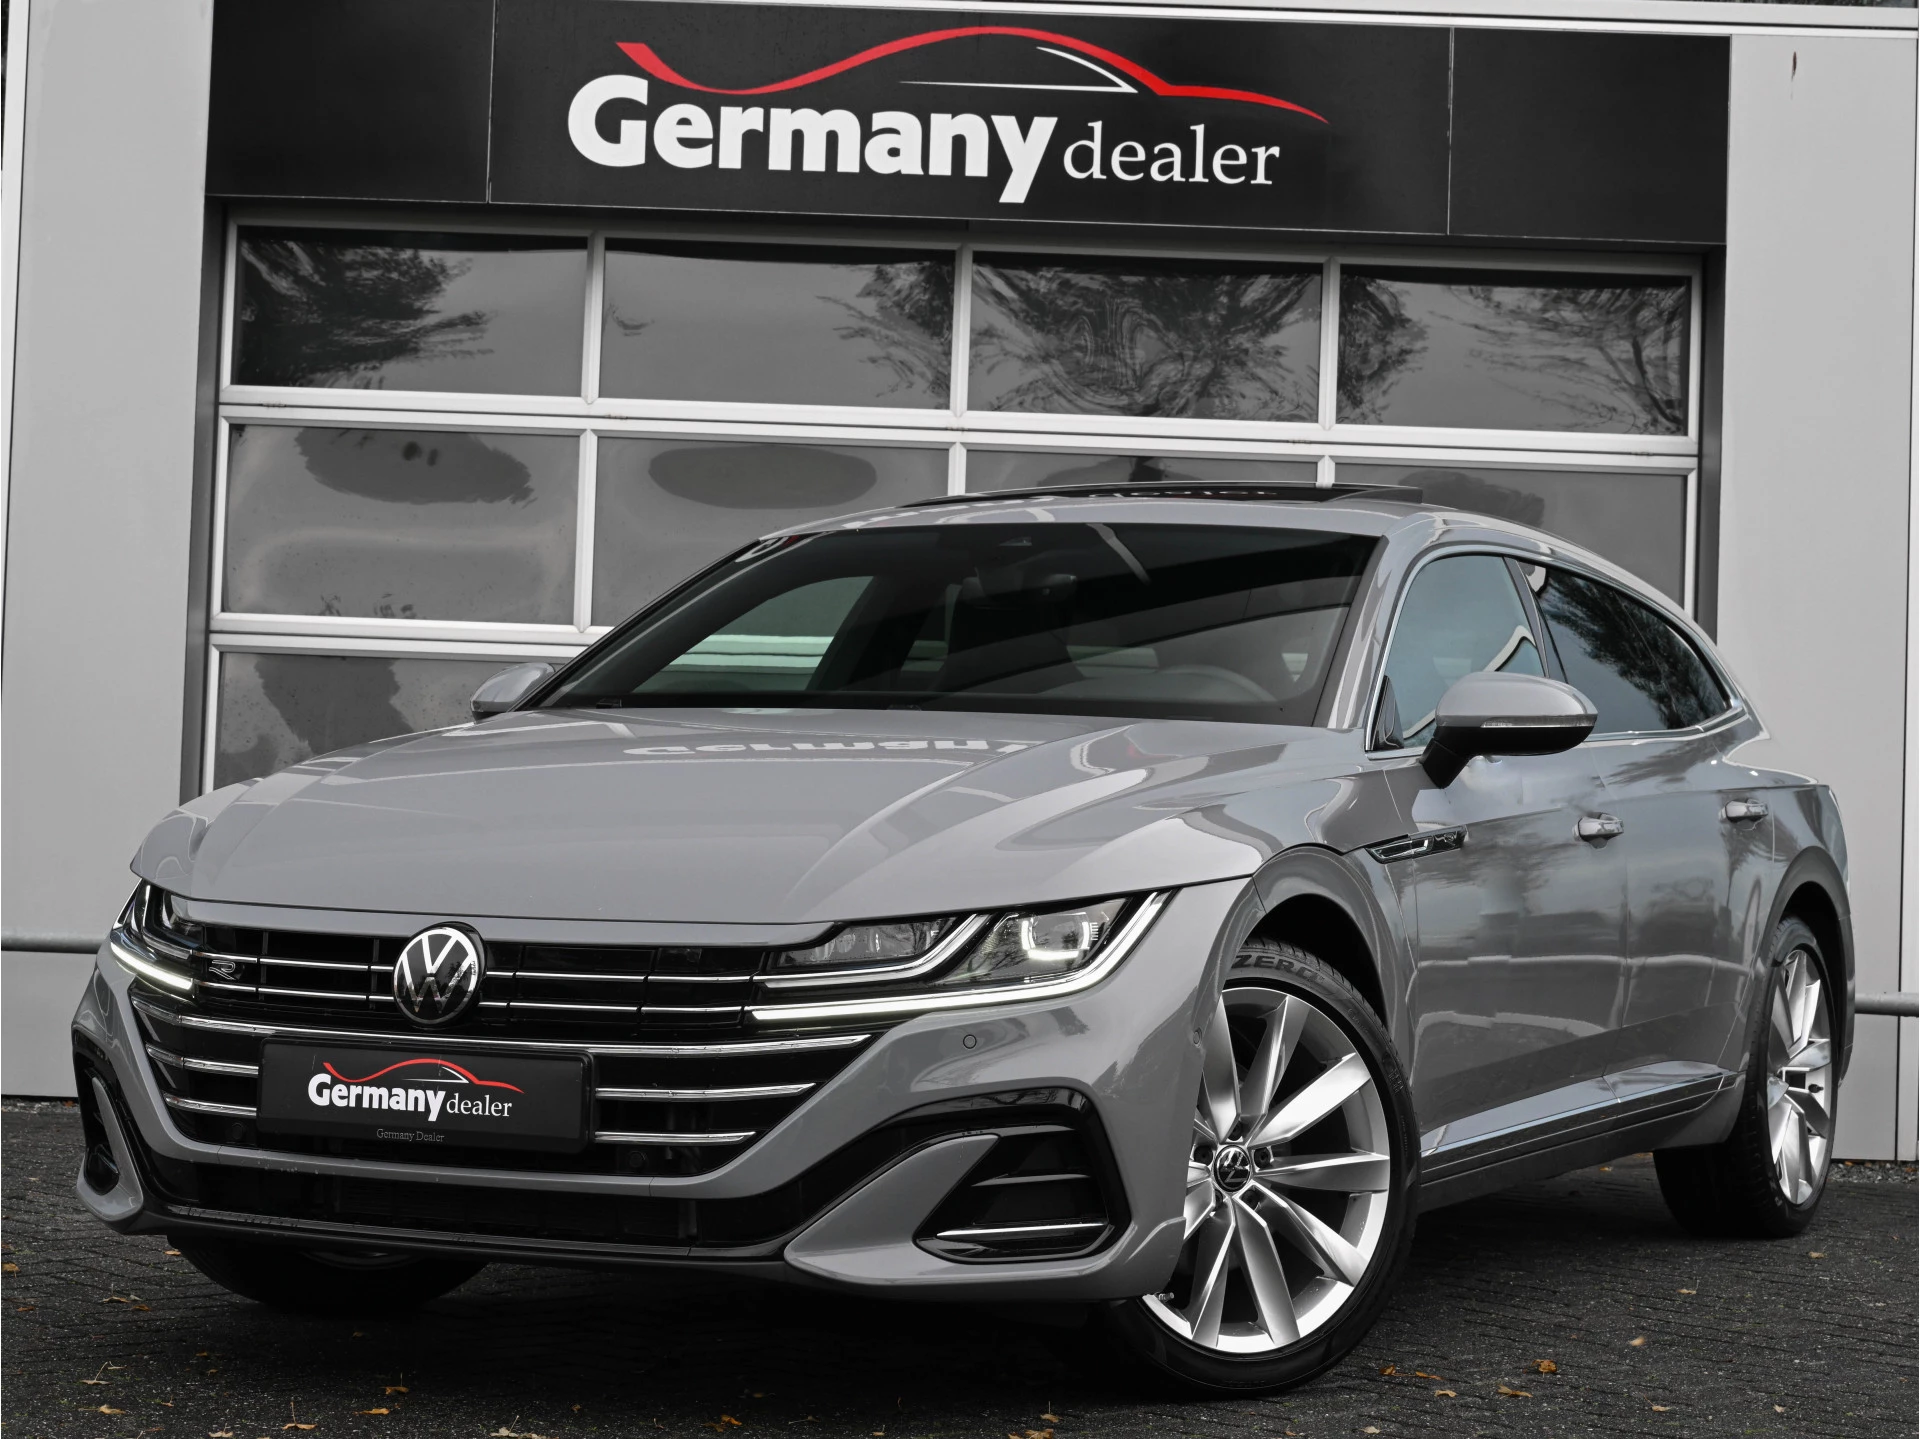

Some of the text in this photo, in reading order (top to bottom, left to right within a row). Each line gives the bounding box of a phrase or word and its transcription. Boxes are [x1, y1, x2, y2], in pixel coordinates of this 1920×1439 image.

[568, 75, 1280, 203] Germany dealer
[1231, 954, 1318, 982] ZERO
[308, 1073, 513, 1121] Germany dealer
[376, 1128, 445, 1142] Germany Dealer
